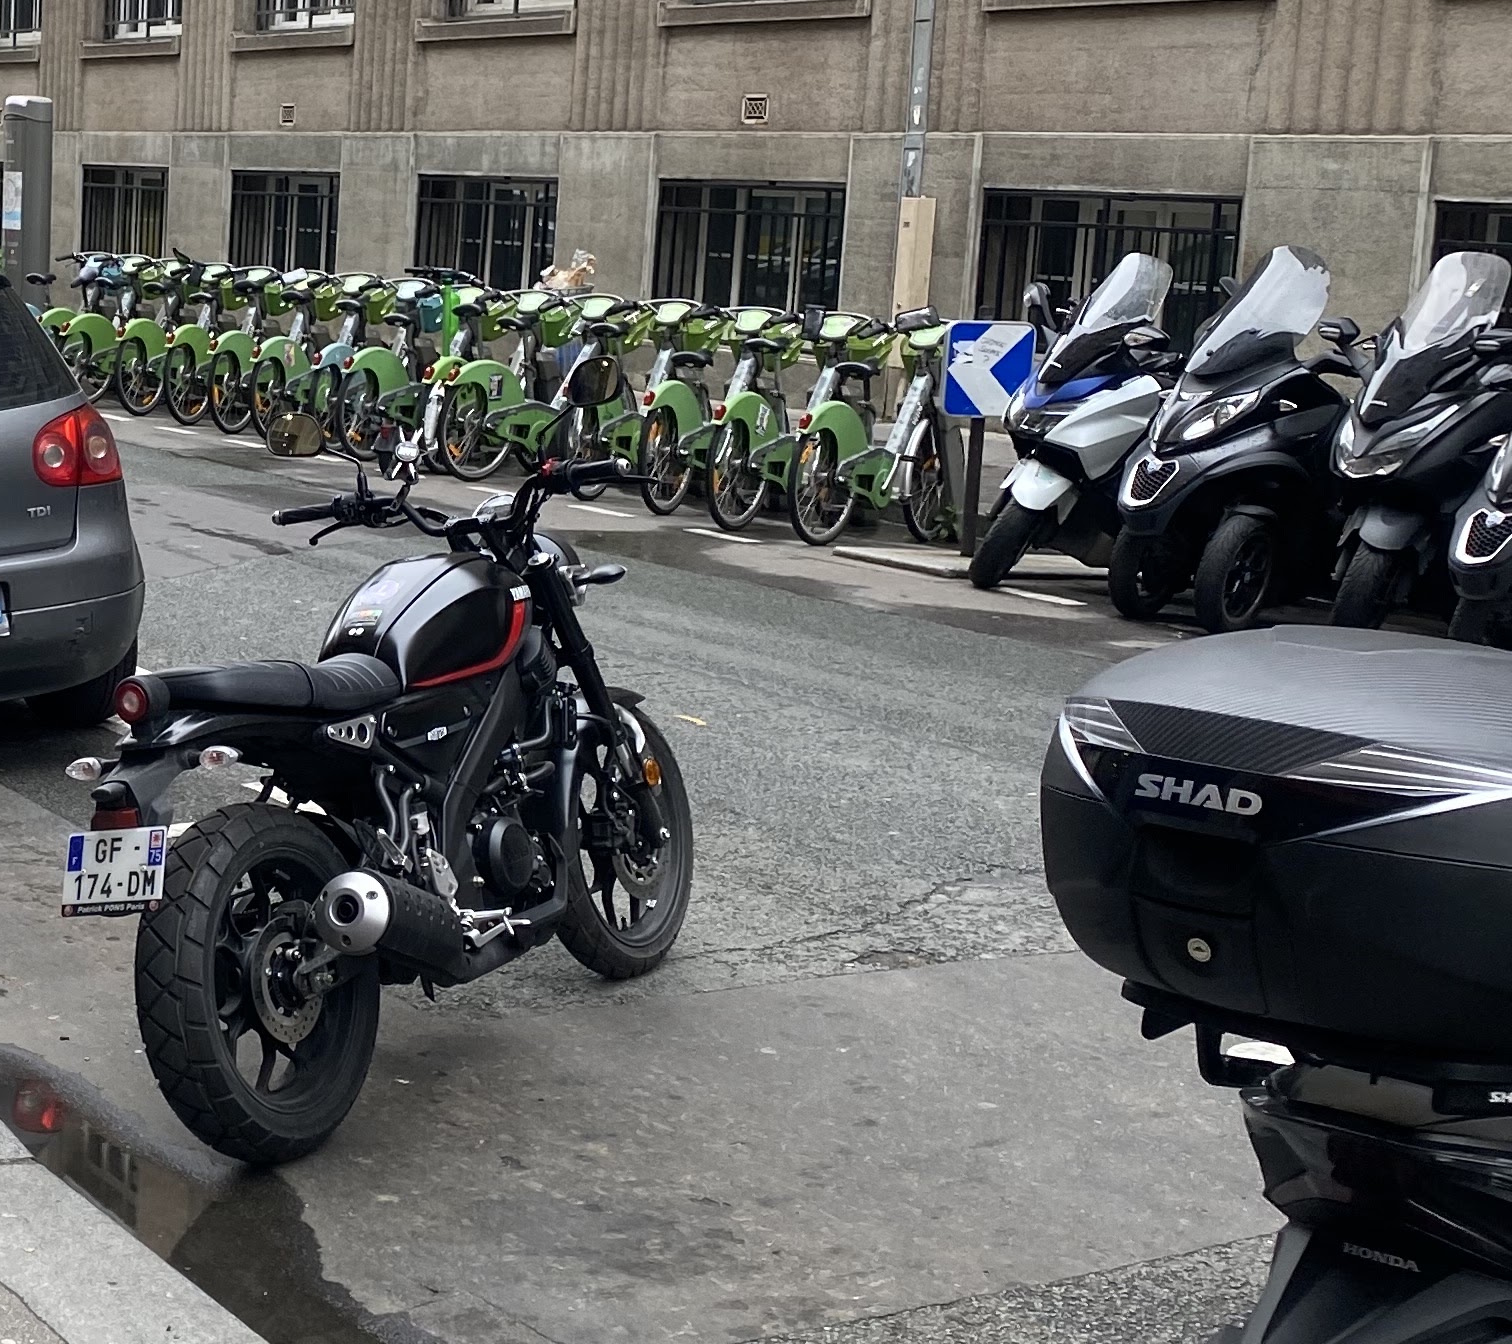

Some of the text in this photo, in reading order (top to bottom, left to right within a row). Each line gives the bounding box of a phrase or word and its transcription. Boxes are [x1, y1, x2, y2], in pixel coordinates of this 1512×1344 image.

[27, 505, 51, 518] TDI
[1134, 773, 1263, 817] SHAD
[72, 856, 79, 866] F
[149, 849, 162, 863] 75
[74, 869, 156, 901] 174-DM
[1342, 1242, 1422, 1273] HONDA
